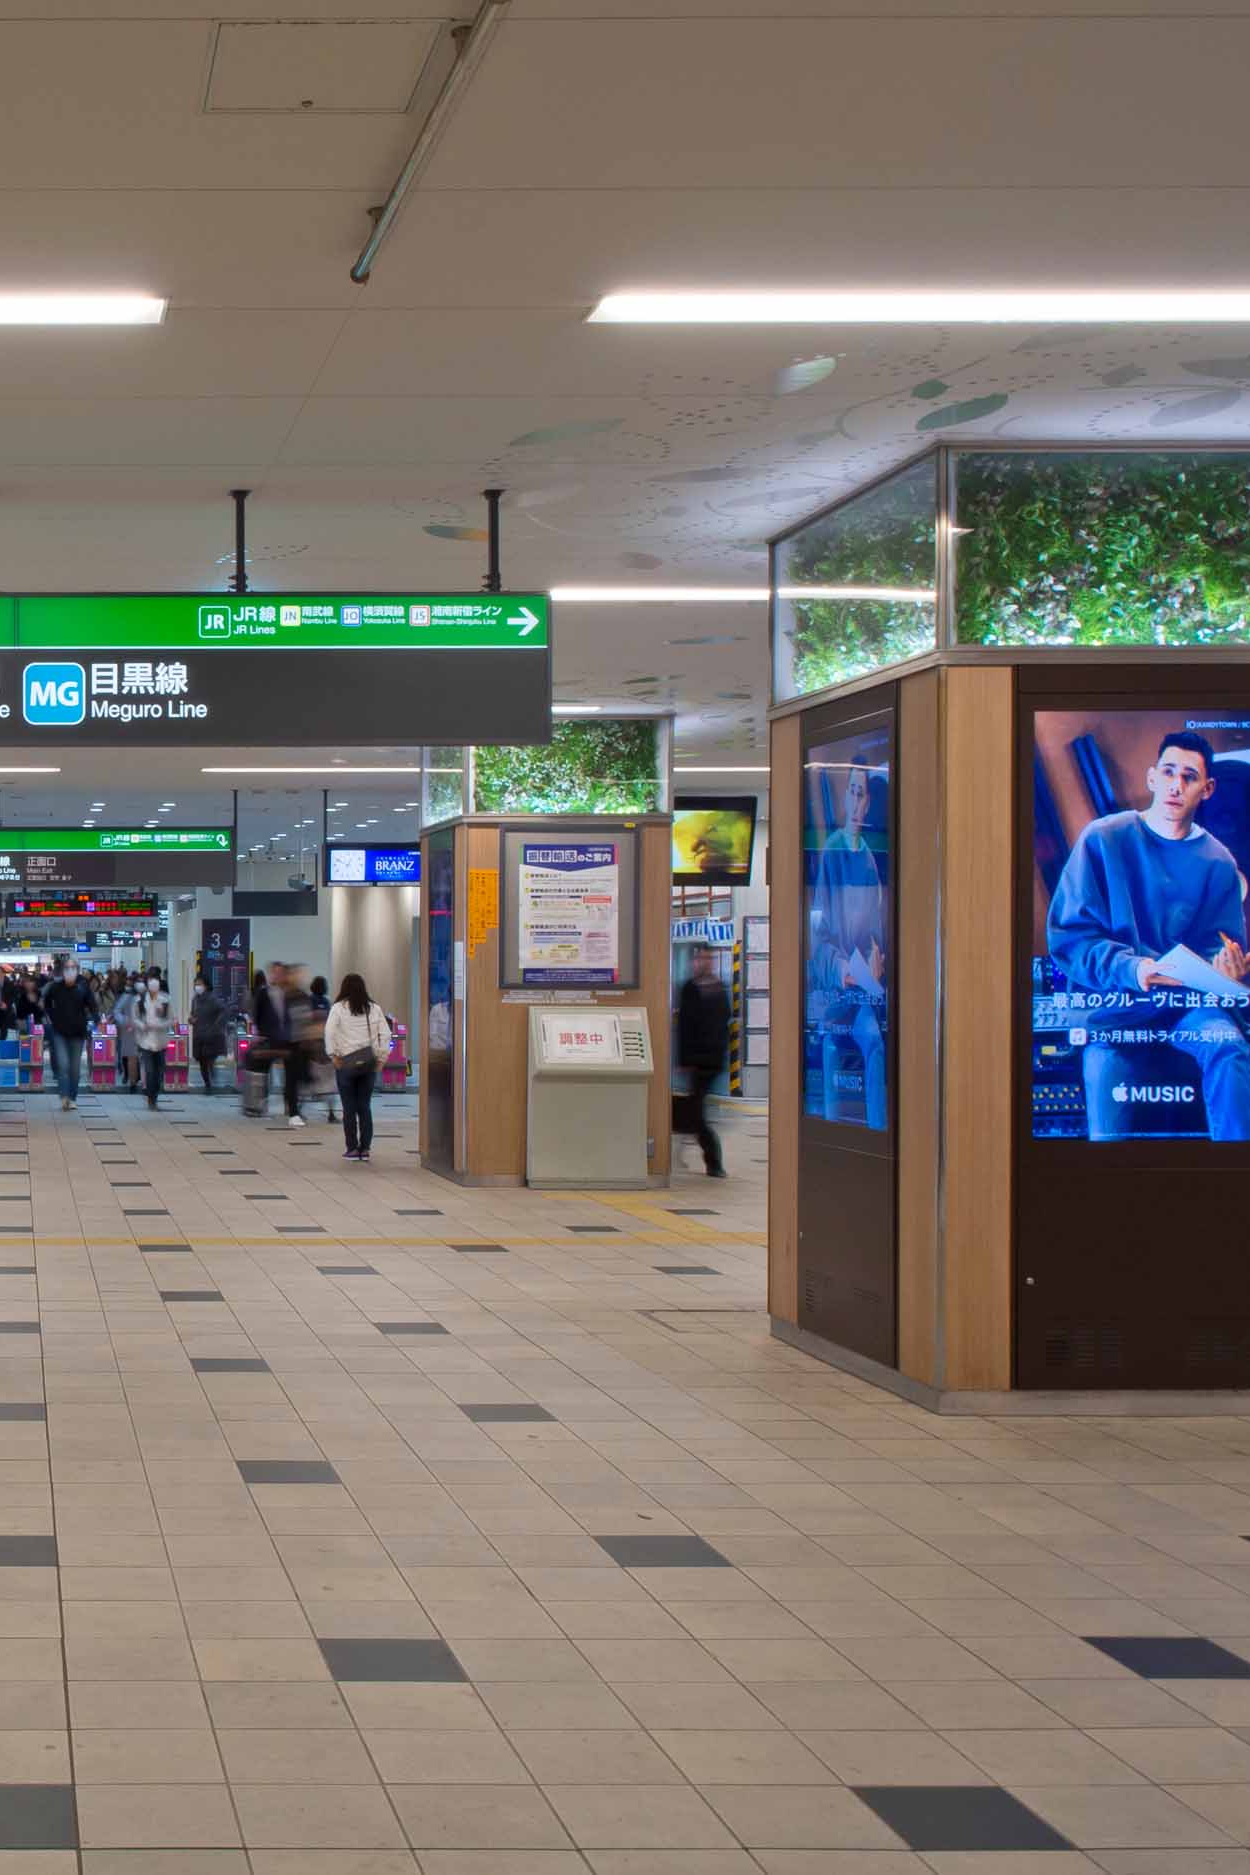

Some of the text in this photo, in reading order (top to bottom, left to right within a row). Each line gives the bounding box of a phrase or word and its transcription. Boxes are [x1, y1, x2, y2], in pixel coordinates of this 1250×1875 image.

[205, 614, 225, 630] JR
[233, 606, 276, 622] JR線
[233, 625, 276, 635] JR Lines
[91, 662, 189, 696] 目黒線
[29, 680, 80, 708] MG
[91, 700, 208, 722] Meguro Line
[375, 860, 415, 871] BRANZ
[211, 932, 241, 949] 3 4
[558, 1032, 604, 1045] 調整中
[1089, 1029, 1238, 1044] 3か月無料トライアル受付中
[1130, 1085, 1196, 1102] MUSIC
